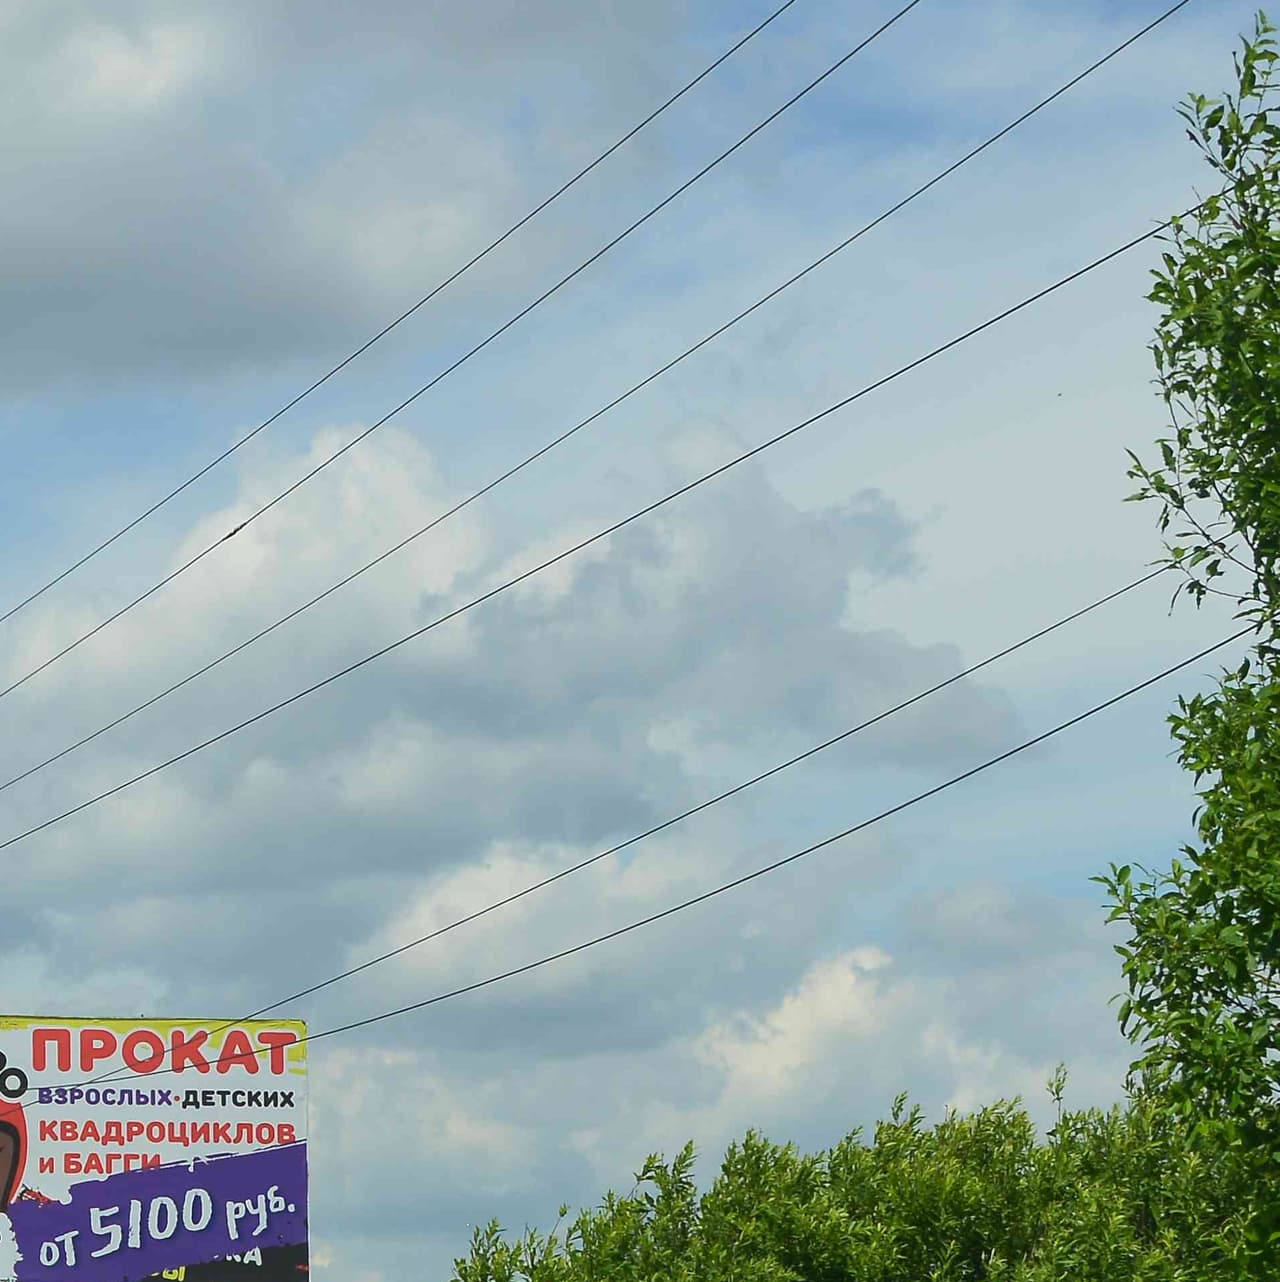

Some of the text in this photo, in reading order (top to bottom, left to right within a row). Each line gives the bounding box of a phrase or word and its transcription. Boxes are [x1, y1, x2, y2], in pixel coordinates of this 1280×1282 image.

[32, 1028, 297, 1075] ПРОКАТ
[38, 1087, 295, 1109] ВЗРОСЛЫХ ДЕТСКИХ
[39, 1120, 296, 1147] КВАДРОЦИКЛОВ
[64, 1153, 161, 1174] БАГГИ
[90, 1188, 213, 1258] 5100
[226, 1185, 296, 1241] руб.
